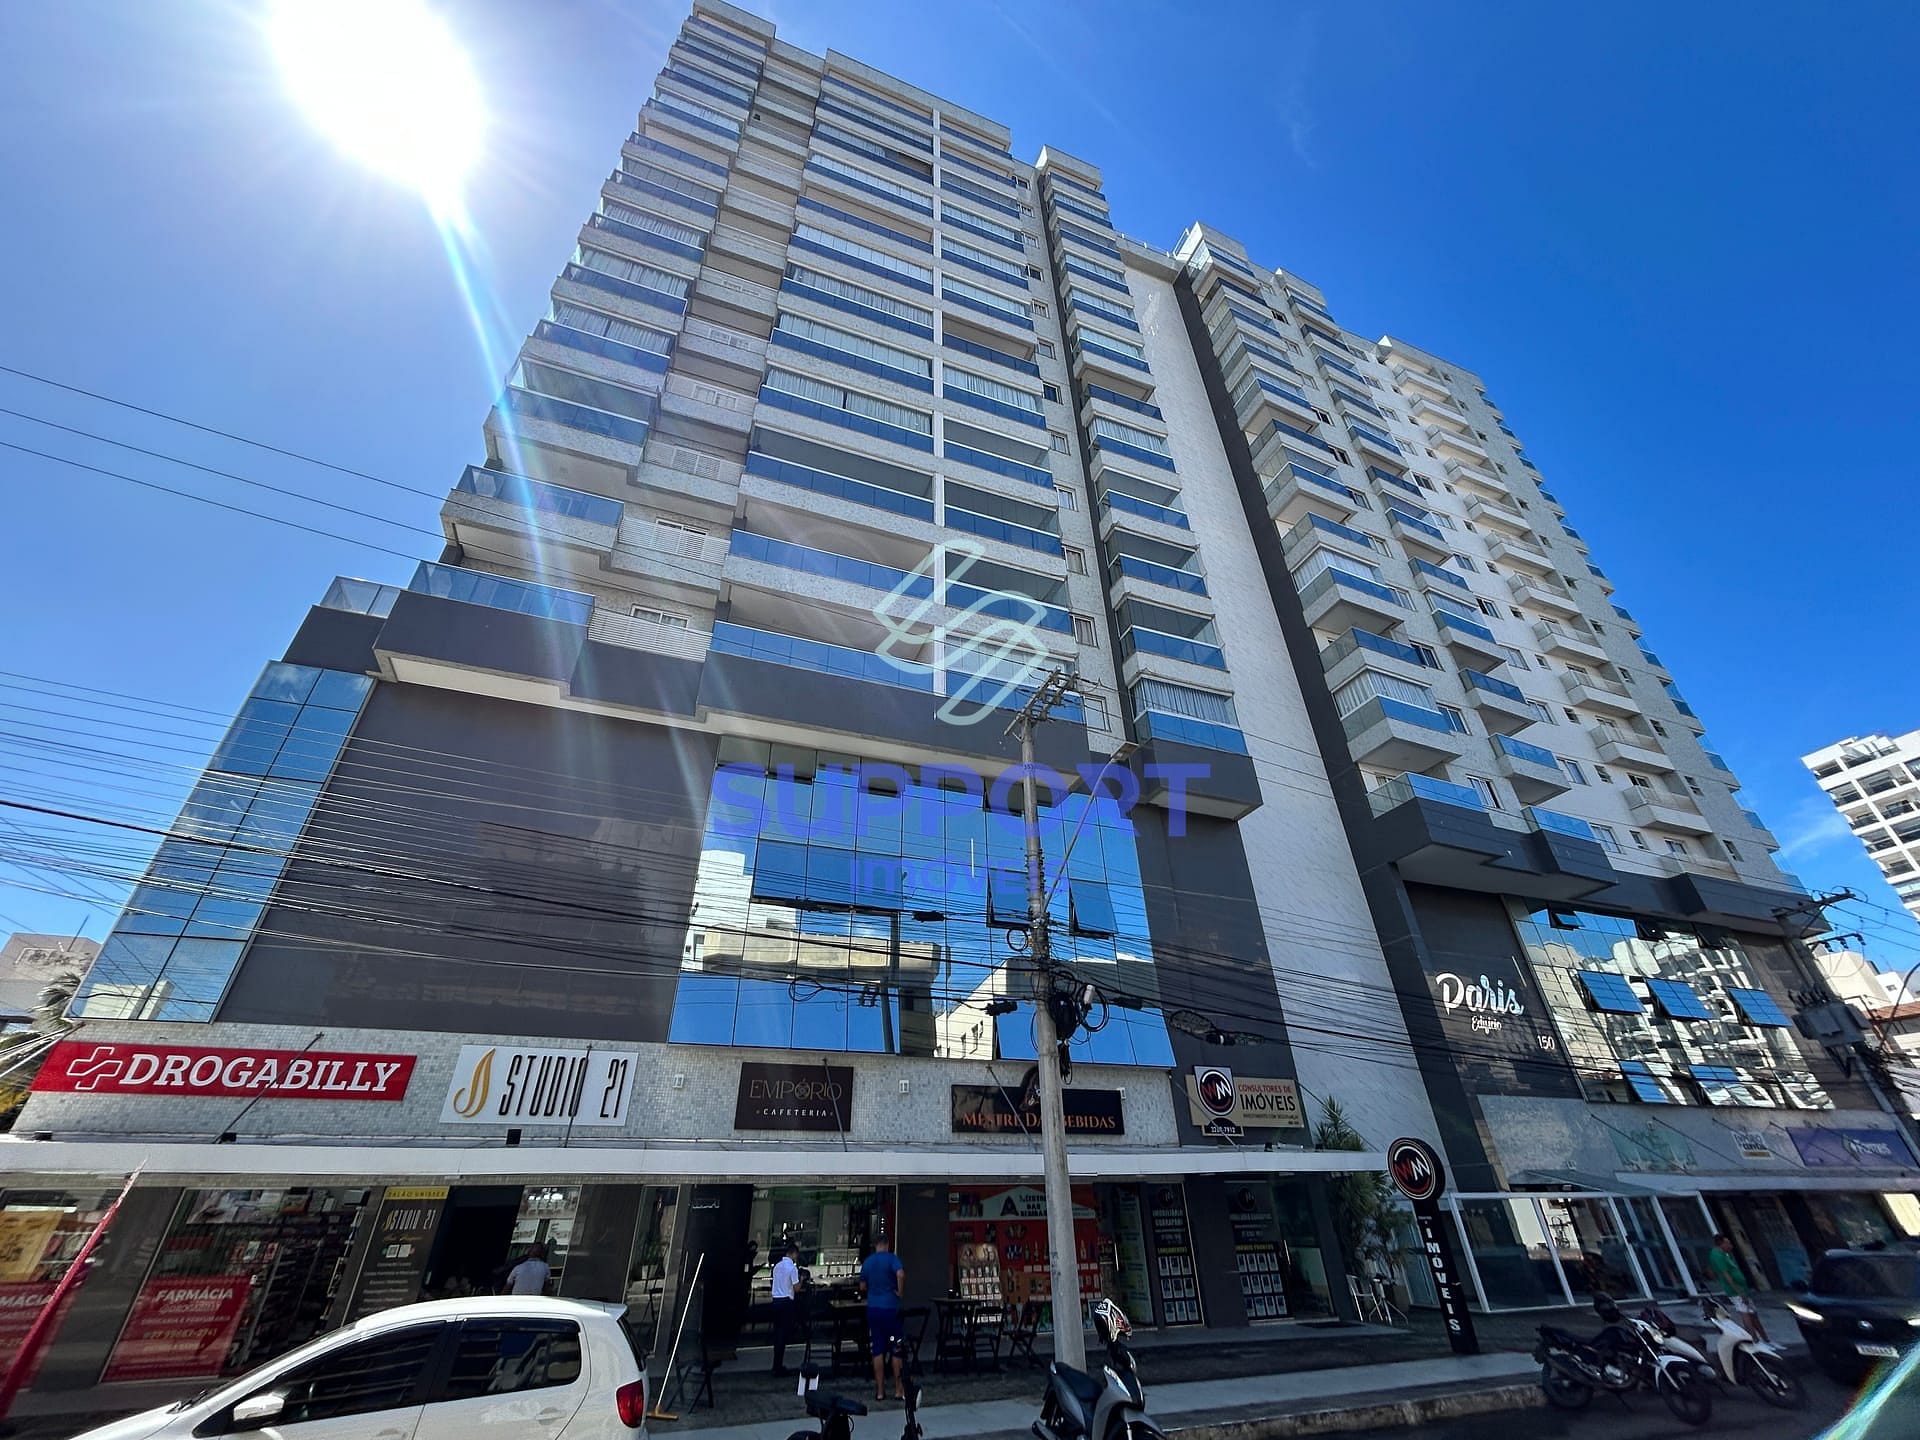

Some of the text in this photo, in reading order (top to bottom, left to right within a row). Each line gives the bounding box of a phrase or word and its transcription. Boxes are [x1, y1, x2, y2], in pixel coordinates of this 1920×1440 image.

[1436, 972, 1525, 1016] Paris
[1537, 1035, 1555, 1050] 150
[119, 1053, 401, 1092] DROGABILLY
[498, 1054, 629, 1118] STUDIO 21
[749, 1077, 842, 1101] EMPÓRIO
[1238, 1083, 1292, 1094] CONSULTORES DE
[763, 1108, 827, 1117] CAFETERIA
[1240, 1092, 1296, 1112] IMÓVEIS
[962, 1111, 1022, 1127] MESTRE
[390, 1209, 437, 1231] STUDIO 21
[1425, 1227, 1461, 1332] IMÓVEIS
[153, 1285, 234, 1303] FARMÁCIA
